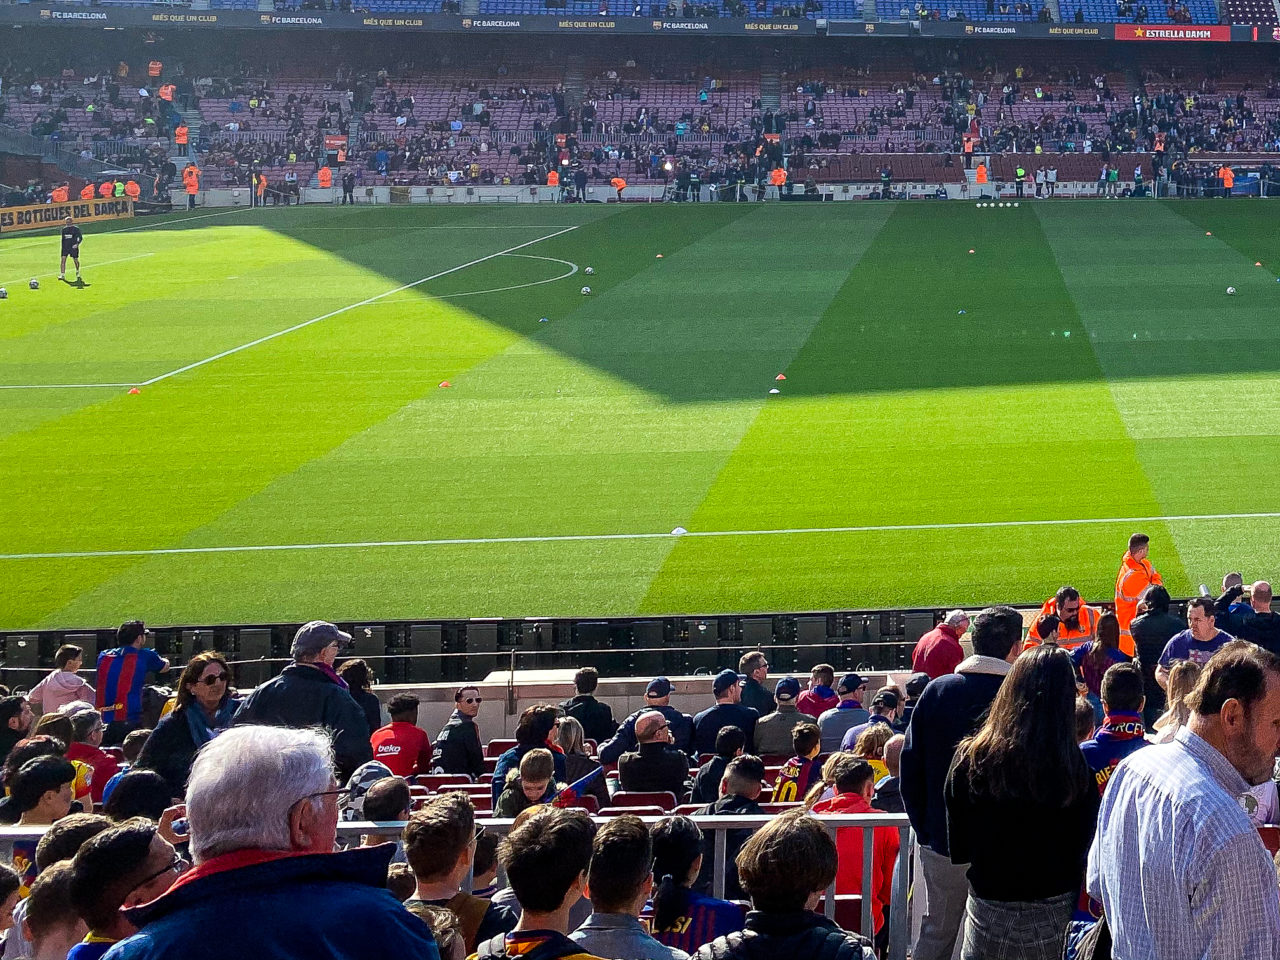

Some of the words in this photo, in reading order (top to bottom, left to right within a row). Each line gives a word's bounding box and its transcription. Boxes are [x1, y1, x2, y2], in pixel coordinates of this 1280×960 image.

[1146, 30, 1184, 38] ESTRELLA
[1186, 30, 1210, 38] DAMM
[17, 205, 71, 225] BOTIGUES
[74, 203, 91, 218] DEL
[94, 199, 129, 217] BARÇA
[378, 744, 401, 752] beko
